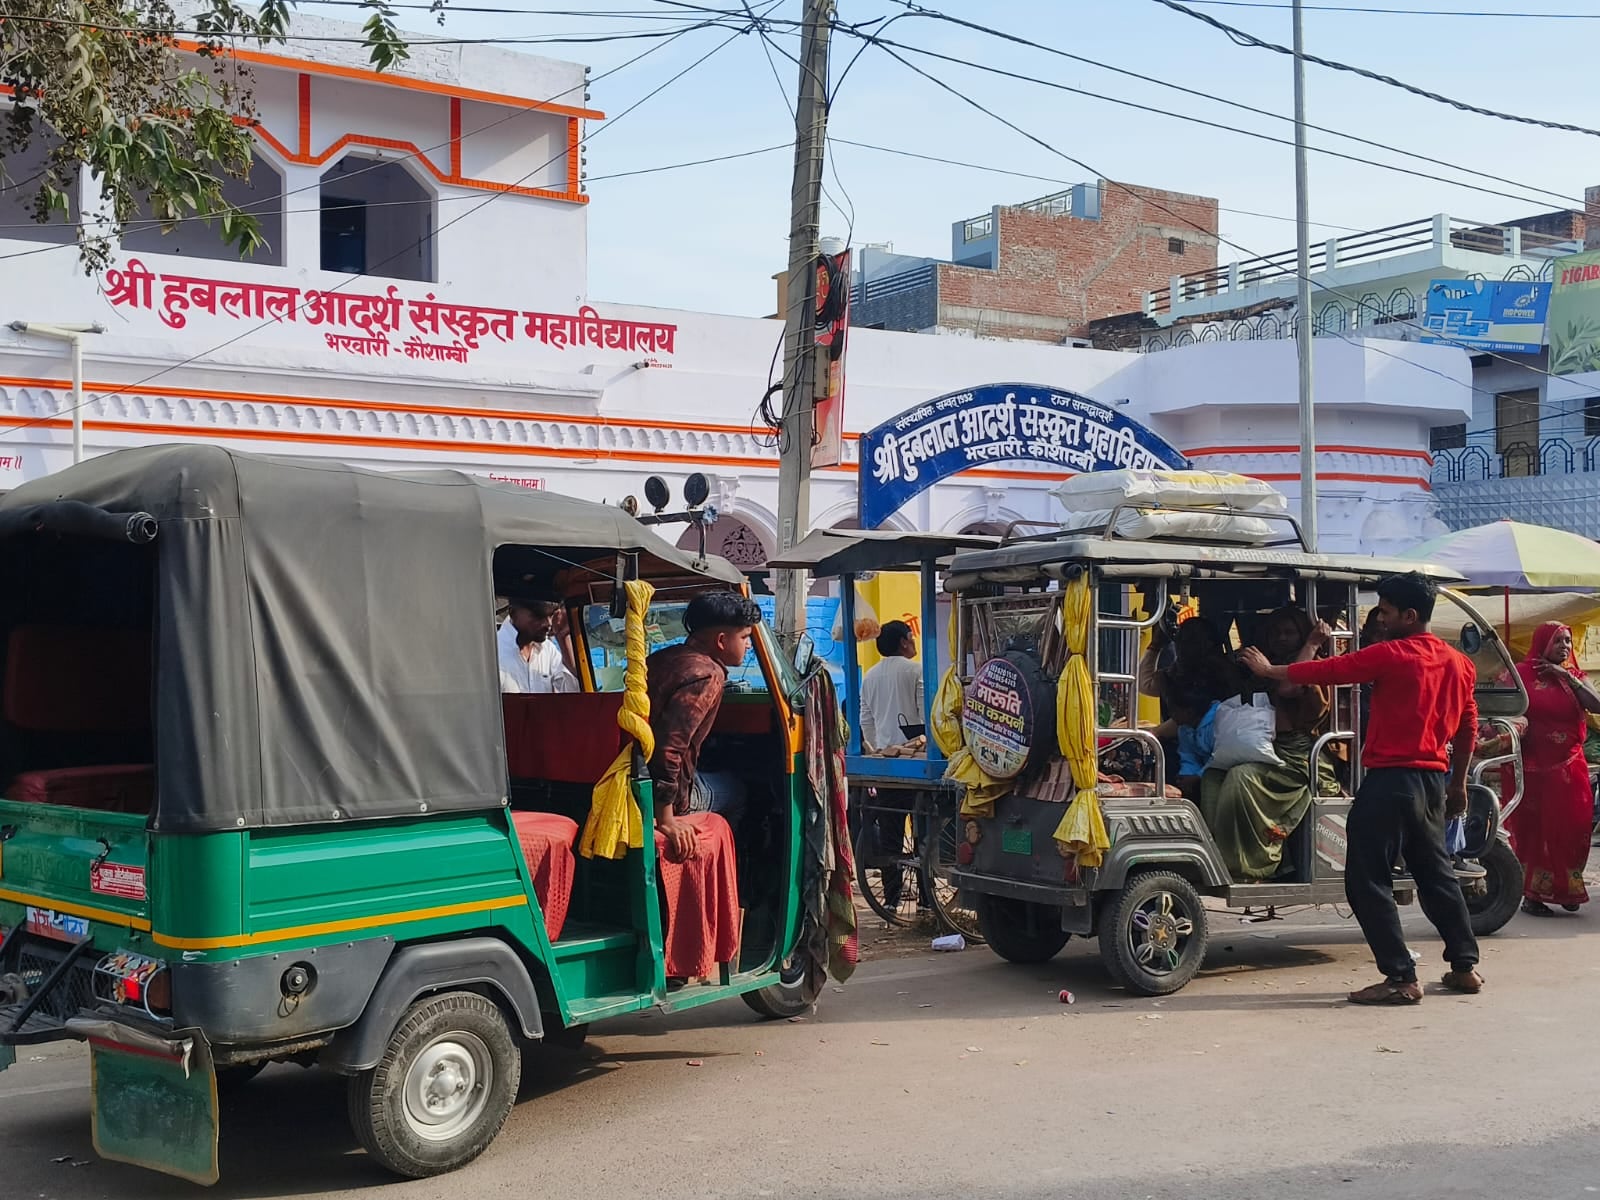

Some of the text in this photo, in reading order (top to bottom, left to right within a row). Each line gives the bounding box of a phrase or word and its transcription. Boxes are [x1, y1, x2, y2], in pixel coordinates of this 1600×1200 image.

[106, 258, 678, 354] श्री हुबलाल आदर्श संस्कृत महाविद्यालय
[324, 331, 390, 357] भरवारी
[402, 335, 469, 364] कौशाम्बी
[873, 392, 1172, 485] श्री हुबलाल आदर्श संस्कृत महाविद्या
